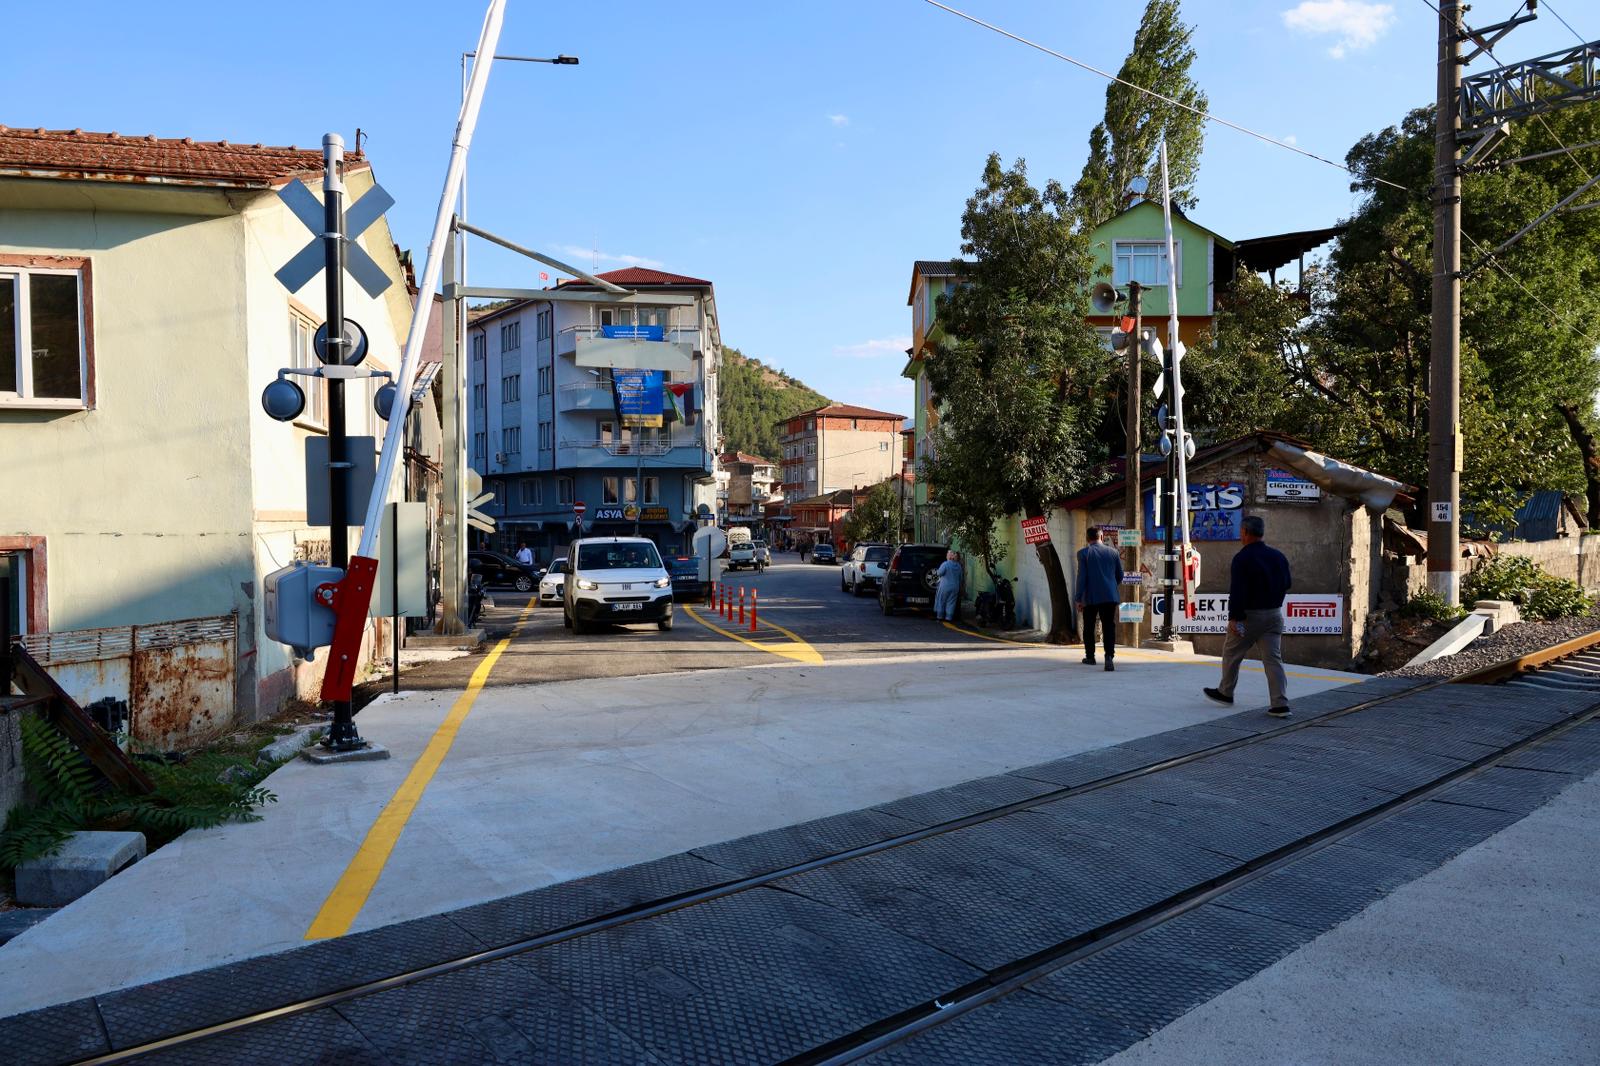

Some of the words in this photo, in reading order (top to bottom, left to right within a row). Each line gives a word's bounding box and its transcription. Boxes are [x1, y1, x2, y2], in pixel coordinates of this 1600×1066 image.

[596, 510, 623, 519] ASYA
[1024, 525, 1047, 537] FARUK
[1287, 602, 1337, 617] PIRELLI
